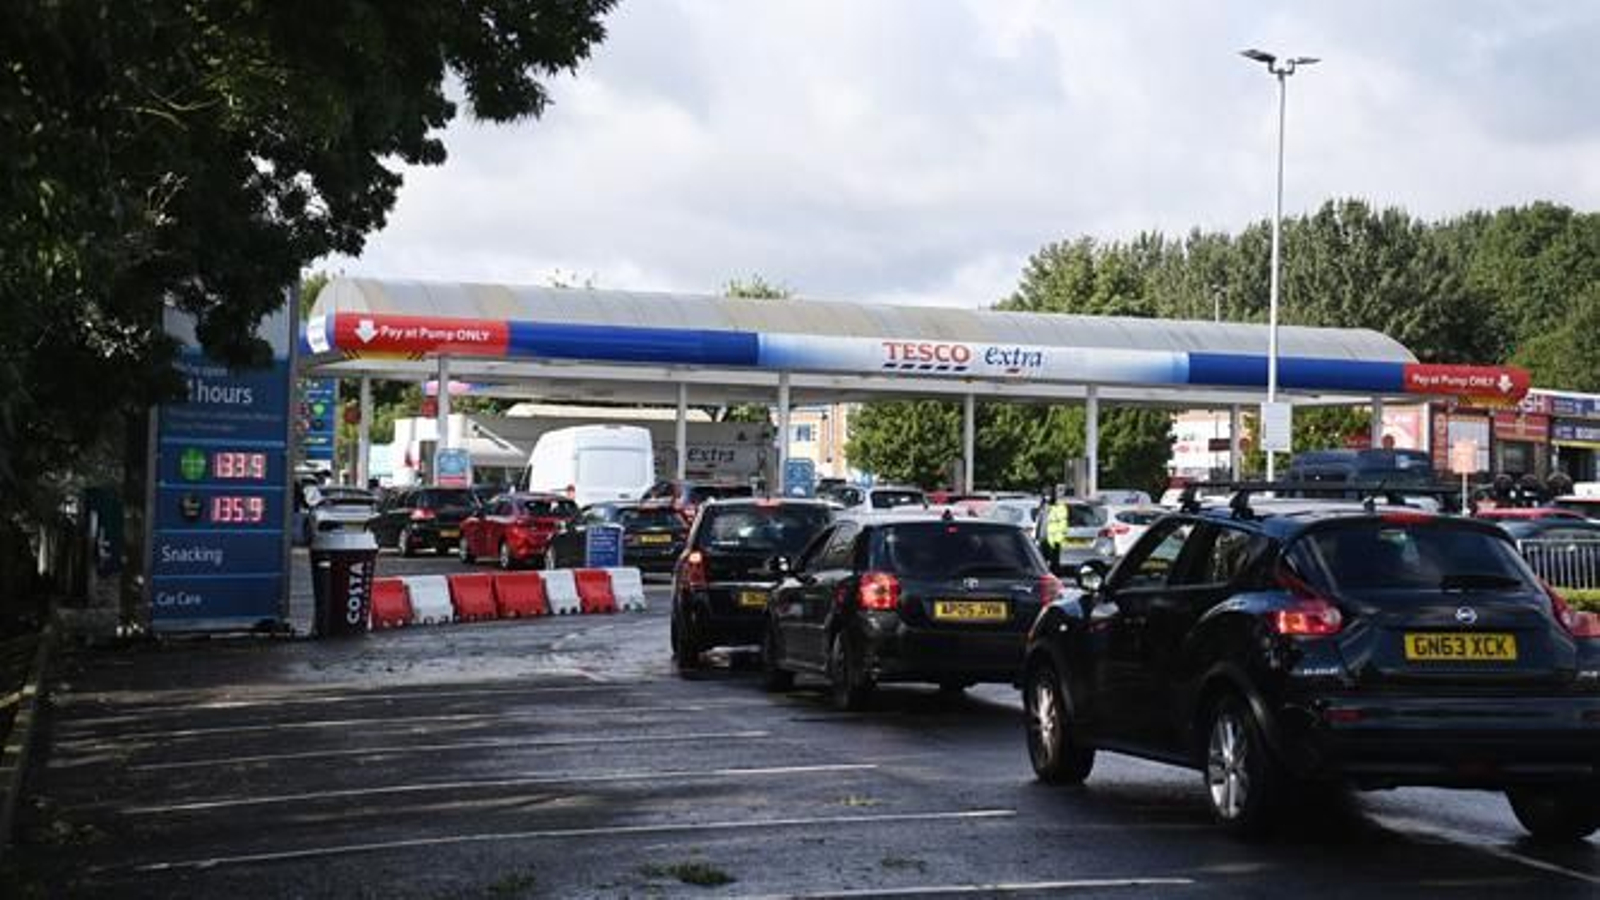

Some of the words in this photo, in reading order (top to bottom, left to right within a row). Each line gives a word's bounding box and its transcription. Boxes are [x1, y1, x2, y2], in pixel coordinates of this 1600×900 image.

[380, 325, 402, 340] Pay
[404, 327, 417, 338] at
[419, 327, 454, 342] Pump
[456, 330, 490, 342] ONLY
[882, 341, 971, 364] TESCO
[984, 346, 1043, 368] extra
[197, 379, 253, 403] hours
[1411, 373, 1430, 387] Pay
[1441, 374, 1468, 388] Pump
[687, 447, 735, 462] extra
[161, 545, 223, 566] Snacking
[156, 592, 176, 606] Car
[177, 592, 202, 606] Care
[346, 562, 364, 625] COSTA
[1413, 636, 1467, 657] GN63
[1471, 636, 1509, 657] XCK
